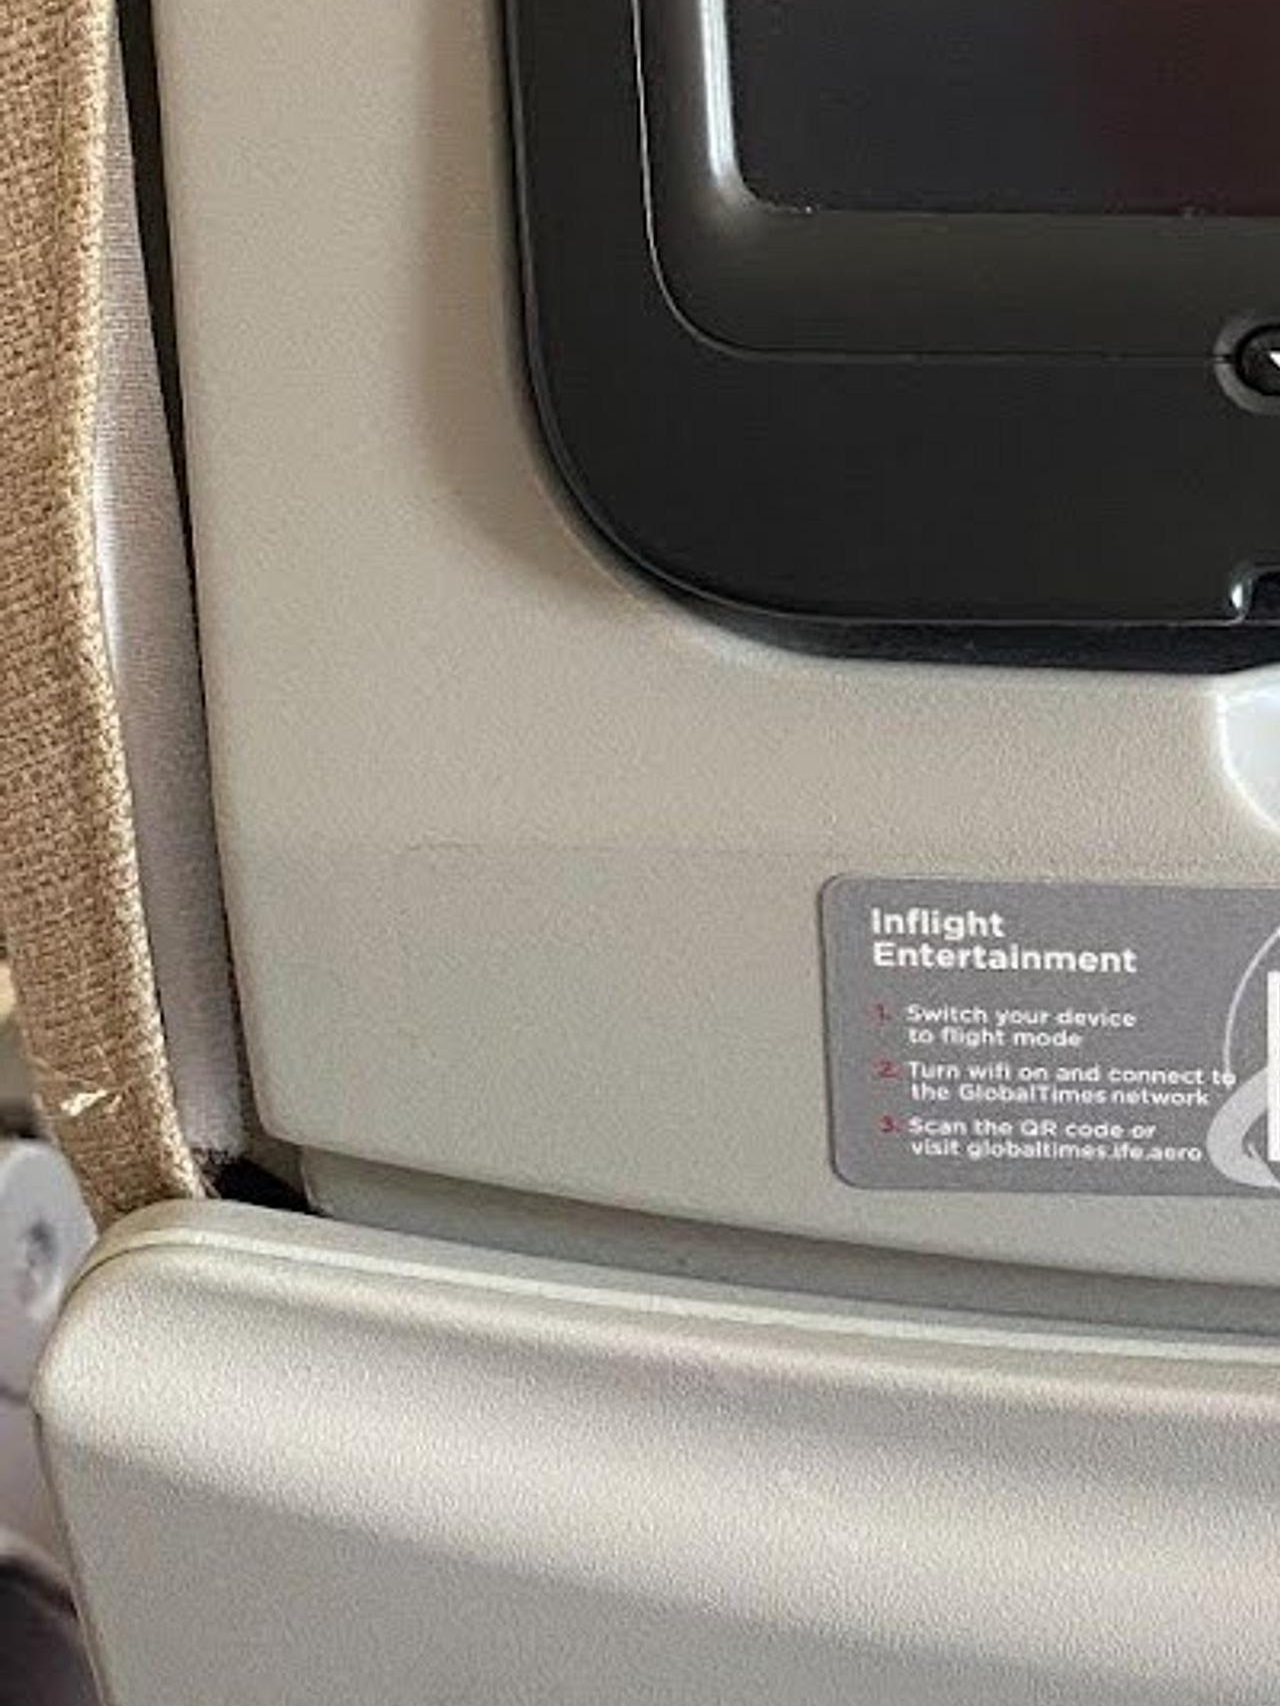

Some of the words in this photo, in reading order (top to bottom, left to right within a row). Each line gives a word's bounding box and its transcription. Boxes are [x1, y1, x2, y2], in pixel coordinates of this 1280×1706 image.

[871, 907, 1005, 941] Inflight
[873, 942, 1138, 973] Entertainment
[907, 1003, 988, 1024] Switch
[995, 1008, 1050, 1027] your
[1055, 1008, 1137, 1028] device
[908, 1028, 934, 1044] to
[940, 1025, 1005, 1047] flight
[1013, 1031, 1083, 1047] mode
[908, 1060, 960, 1080] Turn
[968, 1061, 1012, 1081] wifi
[1018, 1066, 1048, 1081] on
[1056, 1065, 1100, 1082] and
[1107, 1068, 1204, 1085] connect
[1212, 1069, 1237, 1088] to
[911, 1082, 950, 1101] the
[959, 1083, 1107, 1104] GlobalTimes
[1112, 1088, 1209, 1107] network
[908, 1117, 968, 1135] Scan
[974, 1118, 1013, 1135] the
[1020, 1119, 1057, 1137] QR
[1065, 1122, 1124, 1139] code
[1132, 1124, 1156, 1139] or
[911, 1138, 959, 1156] visit
